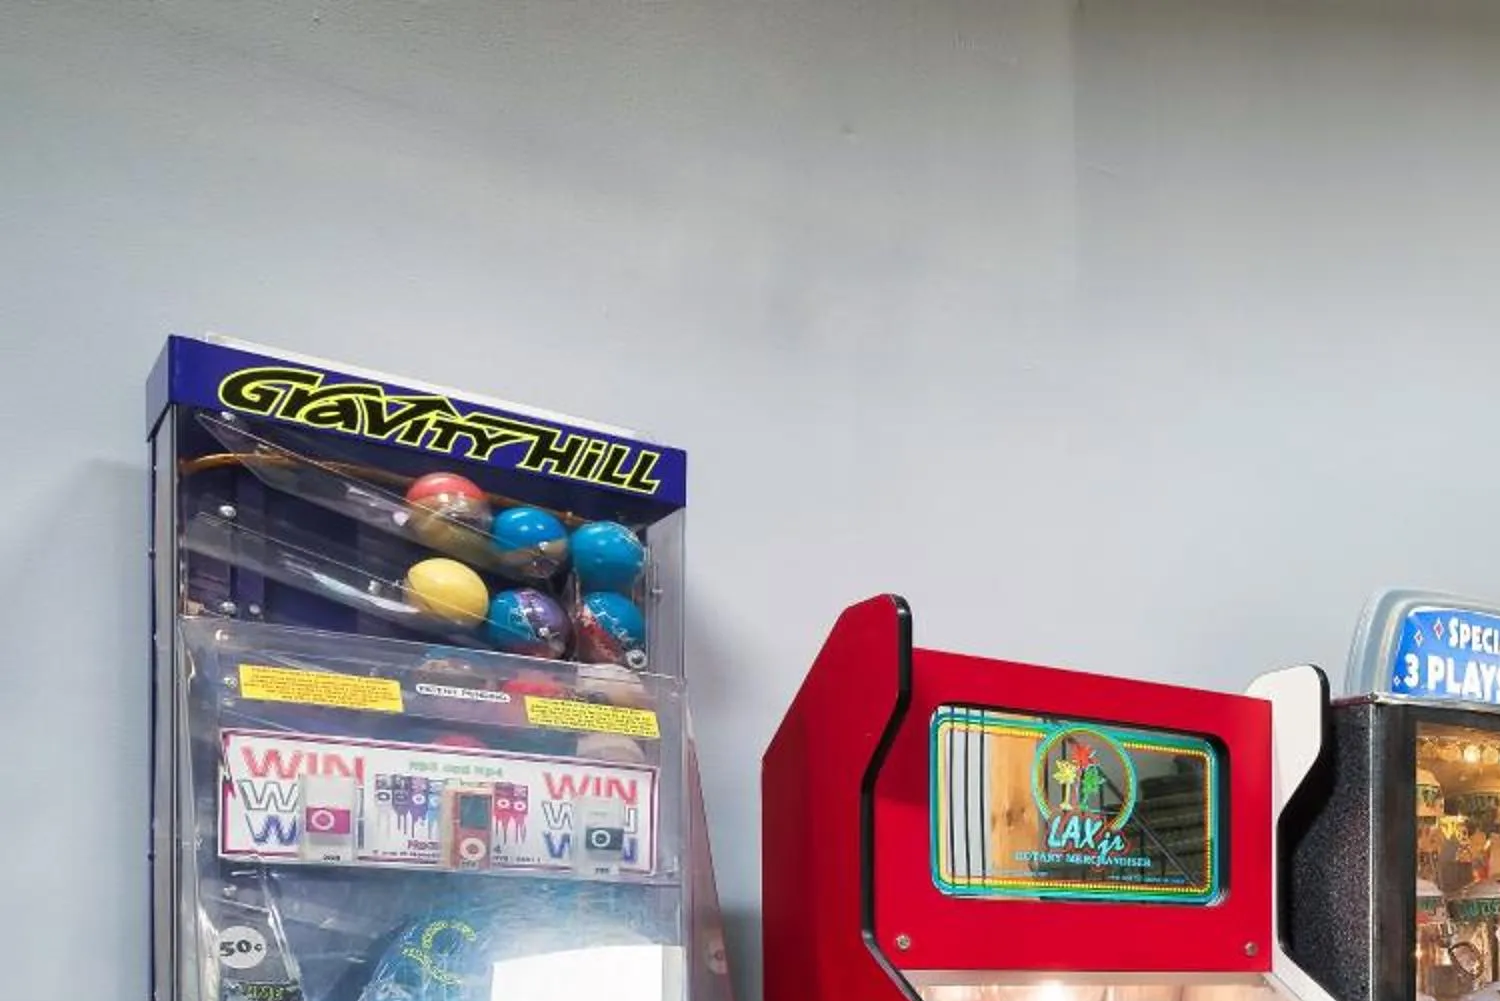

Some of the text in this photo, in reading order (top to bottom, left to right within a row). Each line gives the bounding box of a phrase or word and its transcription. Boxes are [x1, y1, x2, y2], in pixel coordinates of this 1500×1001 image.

[1403, 652, 1420, 688] 3
[240, 746, 365, 786] WIN
[542, 772, 638, 806] WIN
[1047, 816, 1102, 848] LAX
